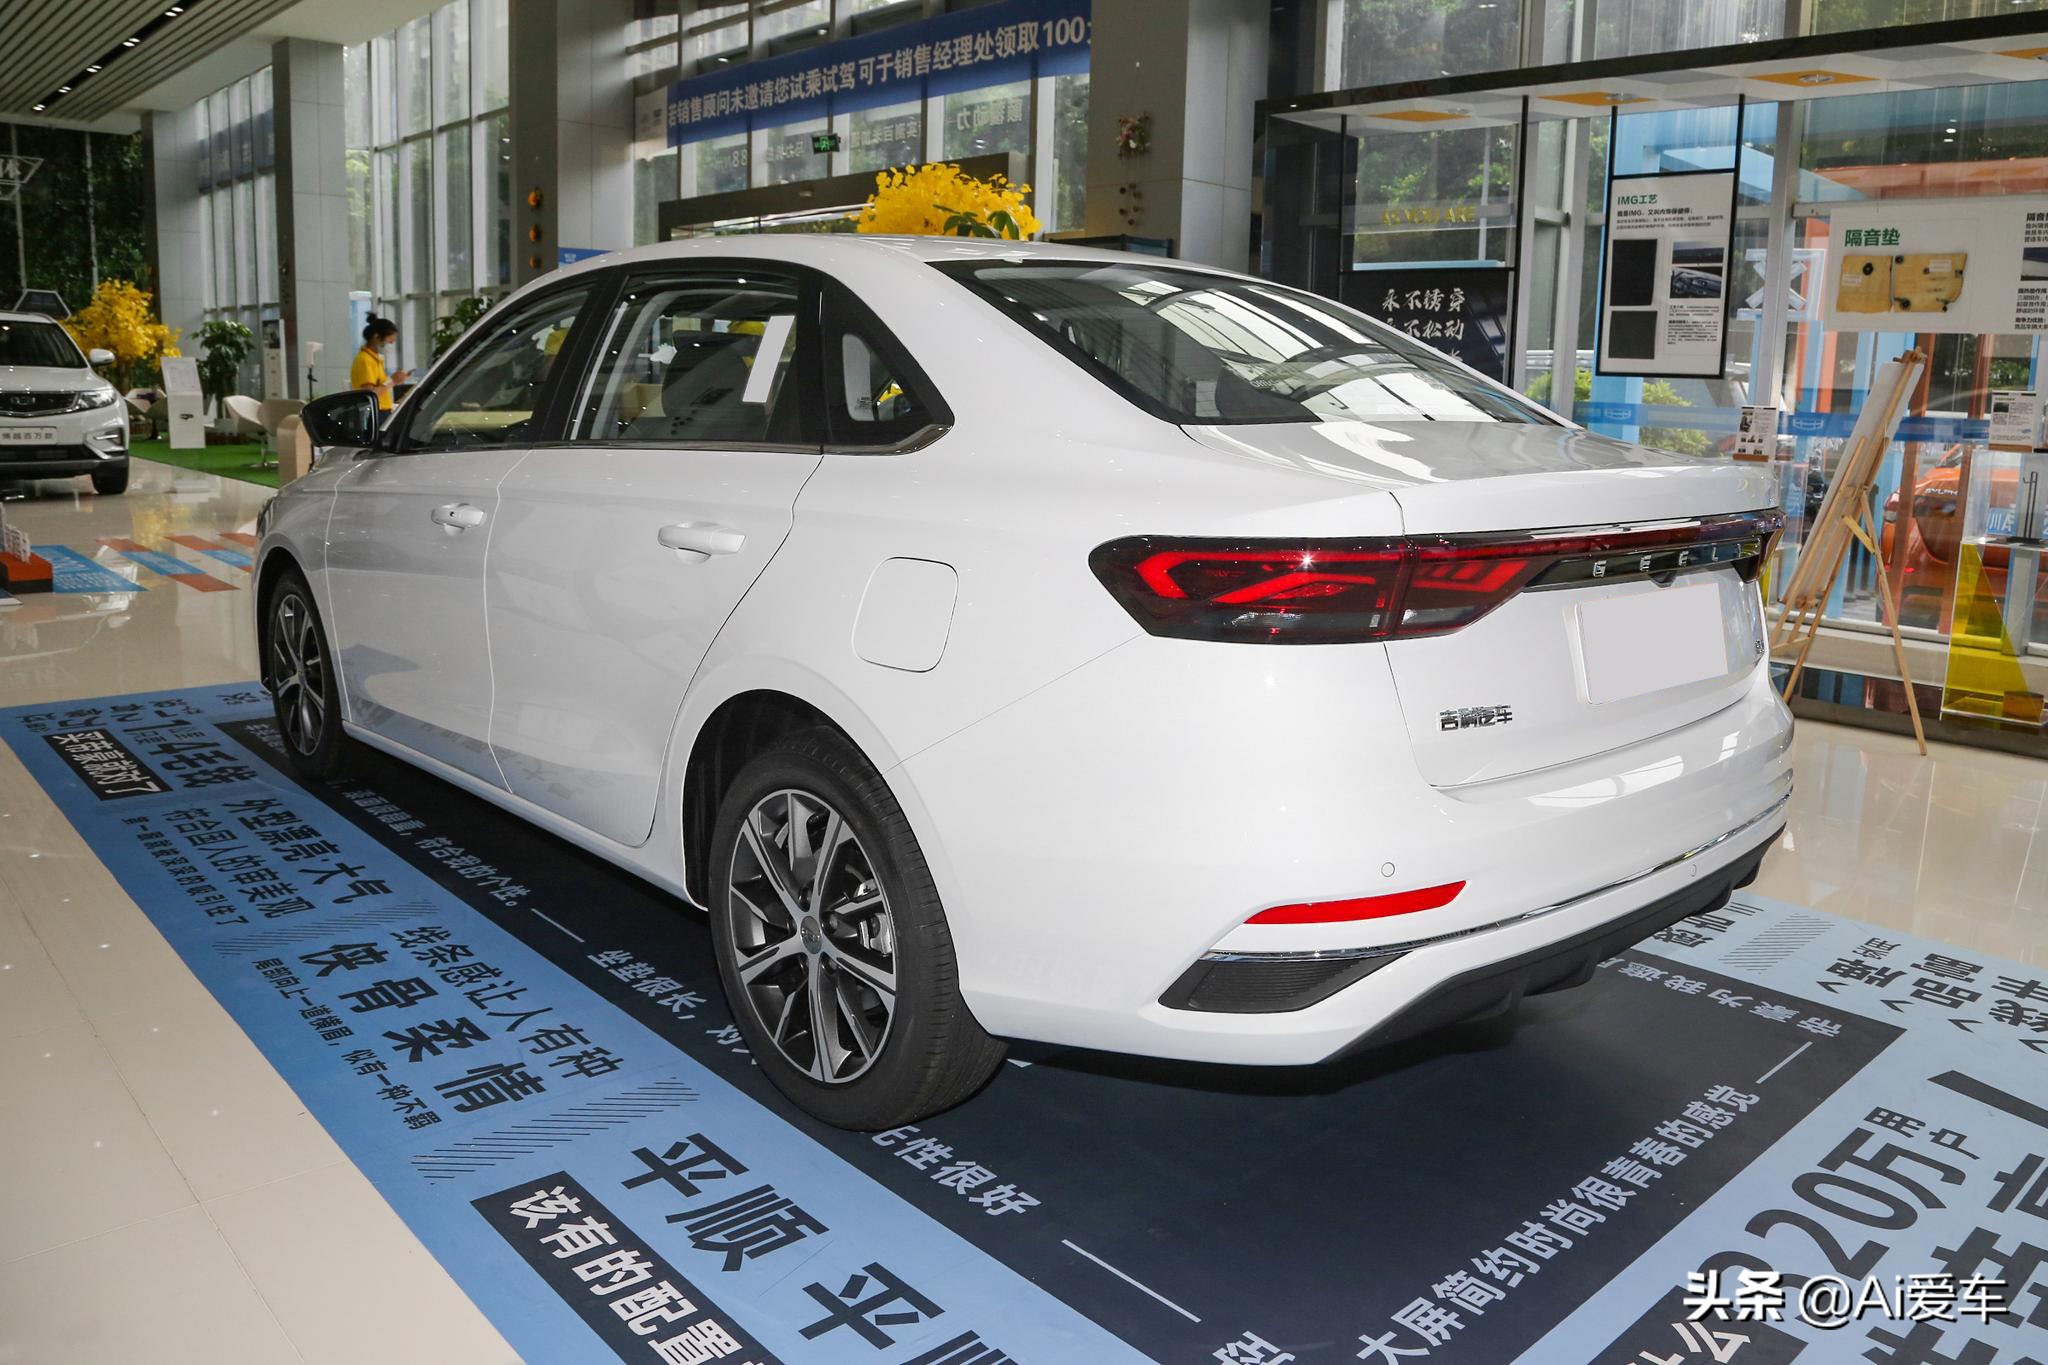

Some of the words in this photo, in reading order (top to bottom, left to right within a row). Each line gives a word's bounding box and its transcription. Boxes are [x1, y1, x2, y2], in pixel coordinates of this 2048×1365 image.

[1043, 15, 1091, 47] 100
[1404, 207, 1440, 225] YOU
[1445, 204, 1477, 223] ARE
[1617, 194, 1658, 205] IMG工艺
[1844, 227, 1900, 247] 隔音垫
[1382, 288, 1466, 312] 永不锈穿
[52, 731, 161, 794] 买帝豪就对了
[121, 815, 249, 926] 第一眼就被深深的吸引住了
[161, 807, 317, 919] 符合国人的审美观
[297, 941, 547, 1115] 侠骨柔情
[389, 925, 625, 1081] 线条感让人有种
[509, 1185, 766, 1365] 该有的配置
[621, 1132, 830, 1272] 平顺
[798, 1262, 1022, 1365] 平
[1356, 1082, 1761, 1365] 大屏简约时尚很青春的感觉
